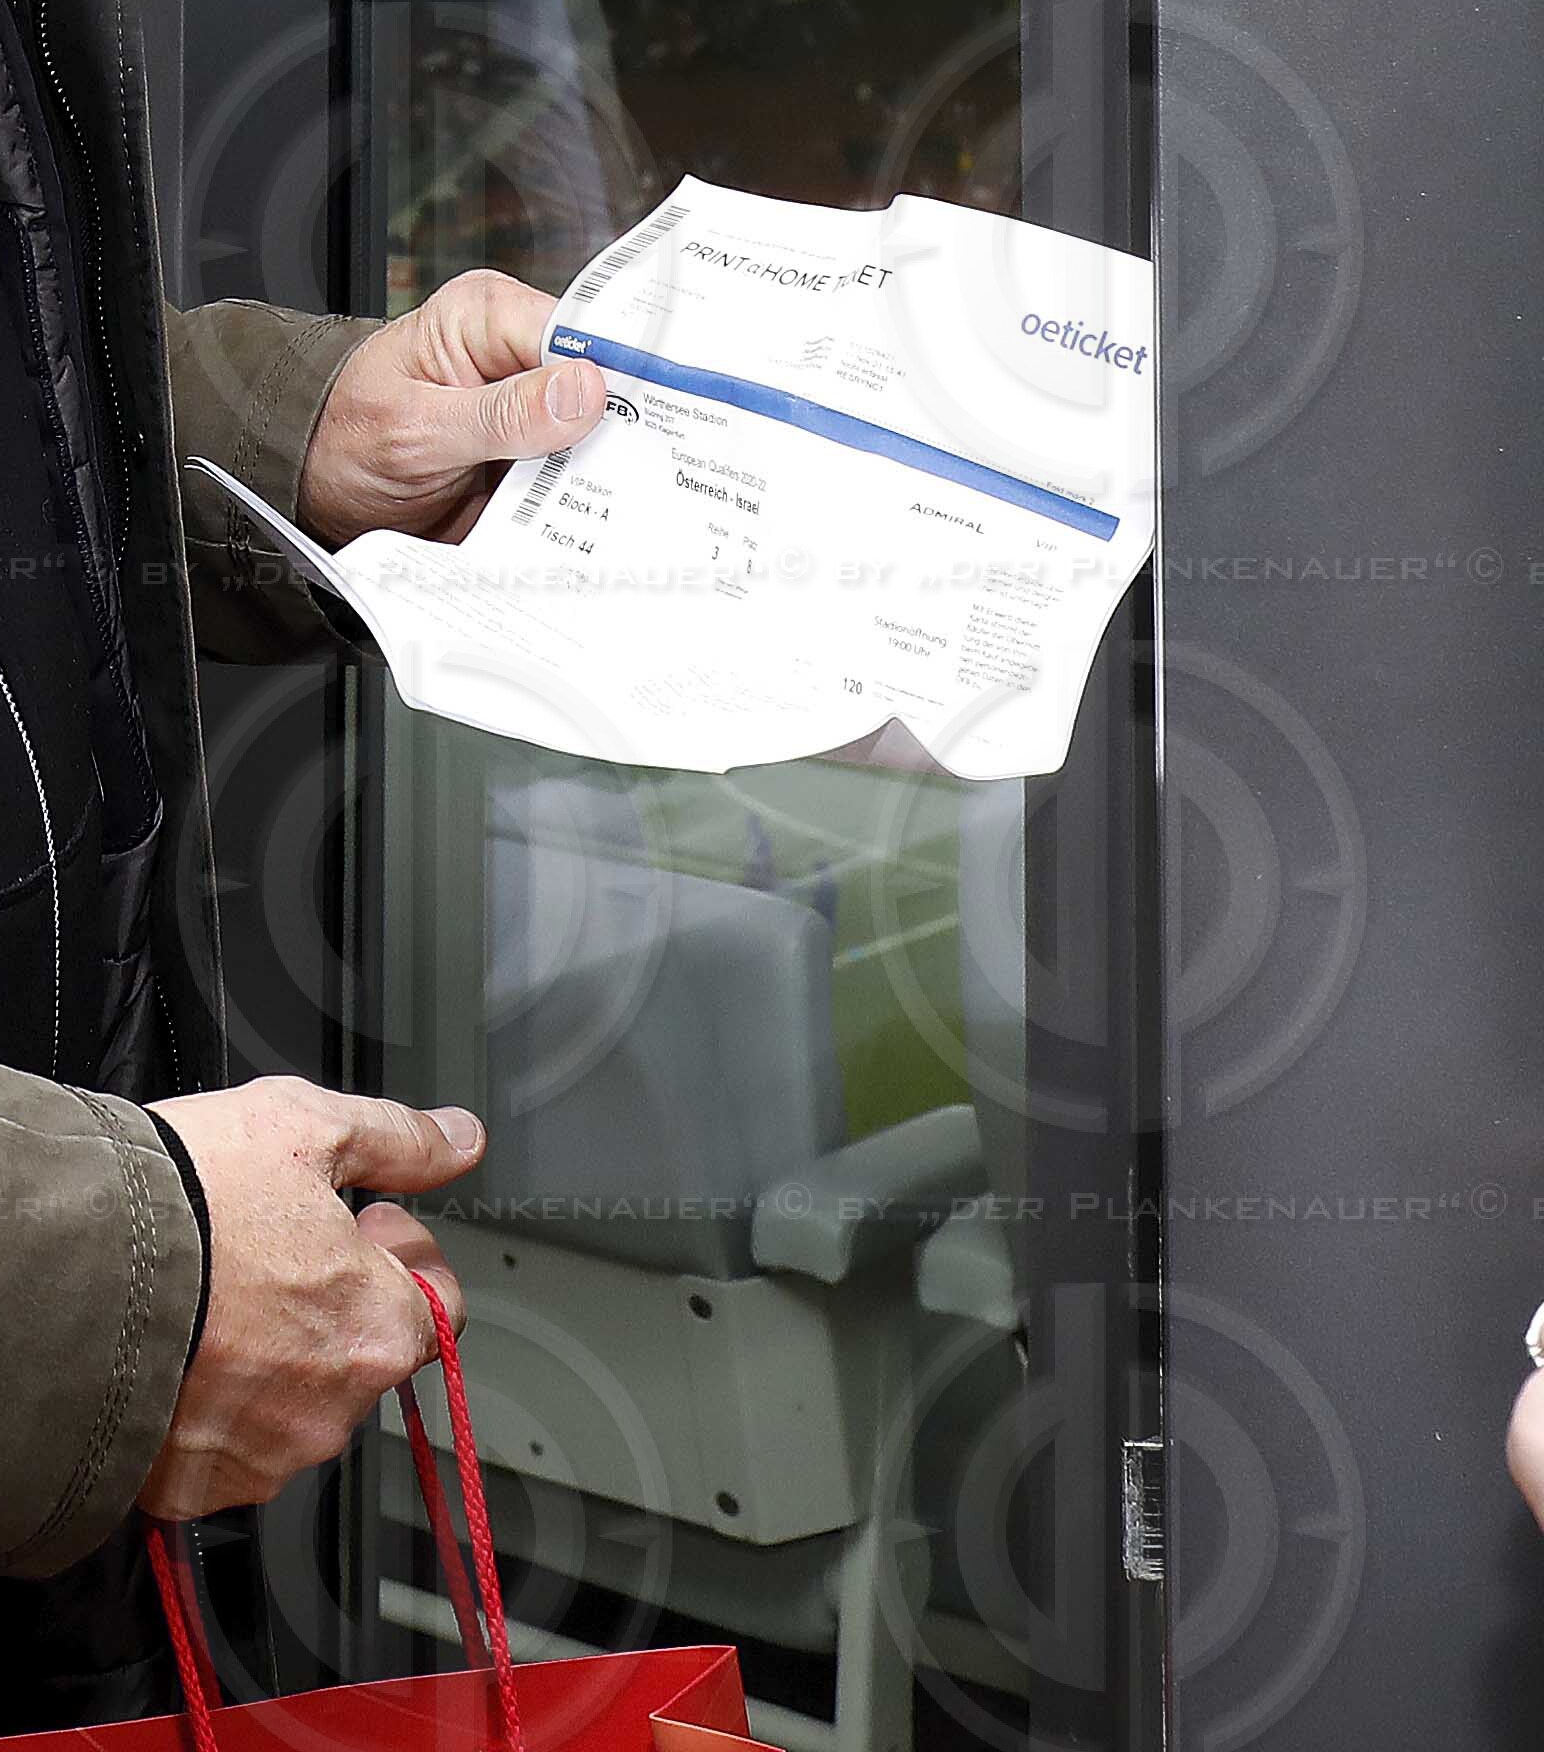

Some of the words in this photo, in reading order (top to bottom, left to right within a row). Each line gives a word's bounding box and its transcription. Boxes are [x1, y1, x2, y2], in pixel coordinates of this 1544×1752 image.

[1021, 313, 1148, 375] oeticket
[606, 400, 628, 417] FB
[676, 467, 728, 503] Österreich
[736, 492, 760, 515] Israel
[558, 492, 592, 516] Block
[600, 507, 610, 521] A
[909, 502, 985, 535] ADMIRAL
[540, 523, 576, 549] Tisch
[578, 540, 595, 555] 44
[711, 545, 720, 561] 3
[843, 676, 863, 696] 120
